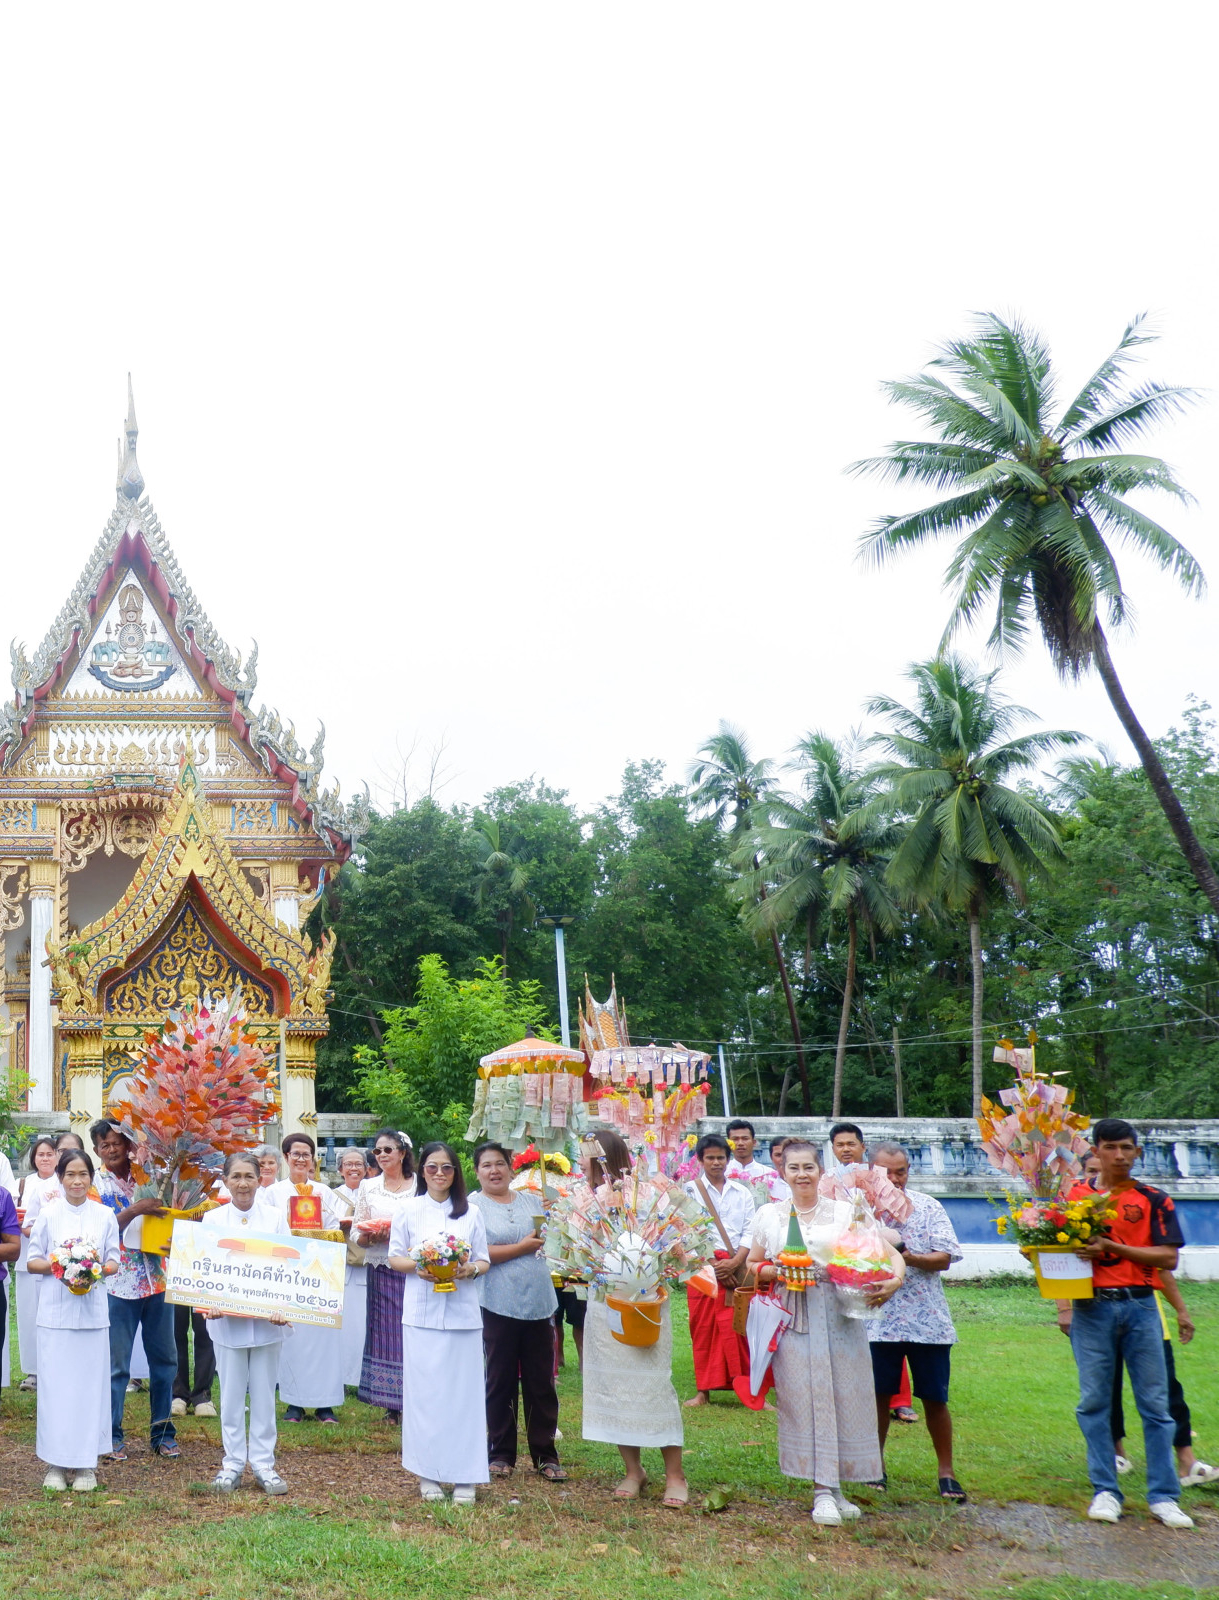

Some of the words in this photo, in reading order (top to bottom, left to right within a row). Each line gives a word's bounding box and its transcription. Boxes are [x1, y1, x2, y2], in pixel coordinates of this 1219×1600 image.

[192, 1257, 321, 1289] กฐินสามัคคีทั่วไทย
[172, 1275, 225, 1291] ๓๐,๐๐๐
[228, 1283, 240, 1294] วัด
[242, 1289, 292, 1302] พุทธศักราช
[295, 1292, 339, 1309] ๒๕๖๘
